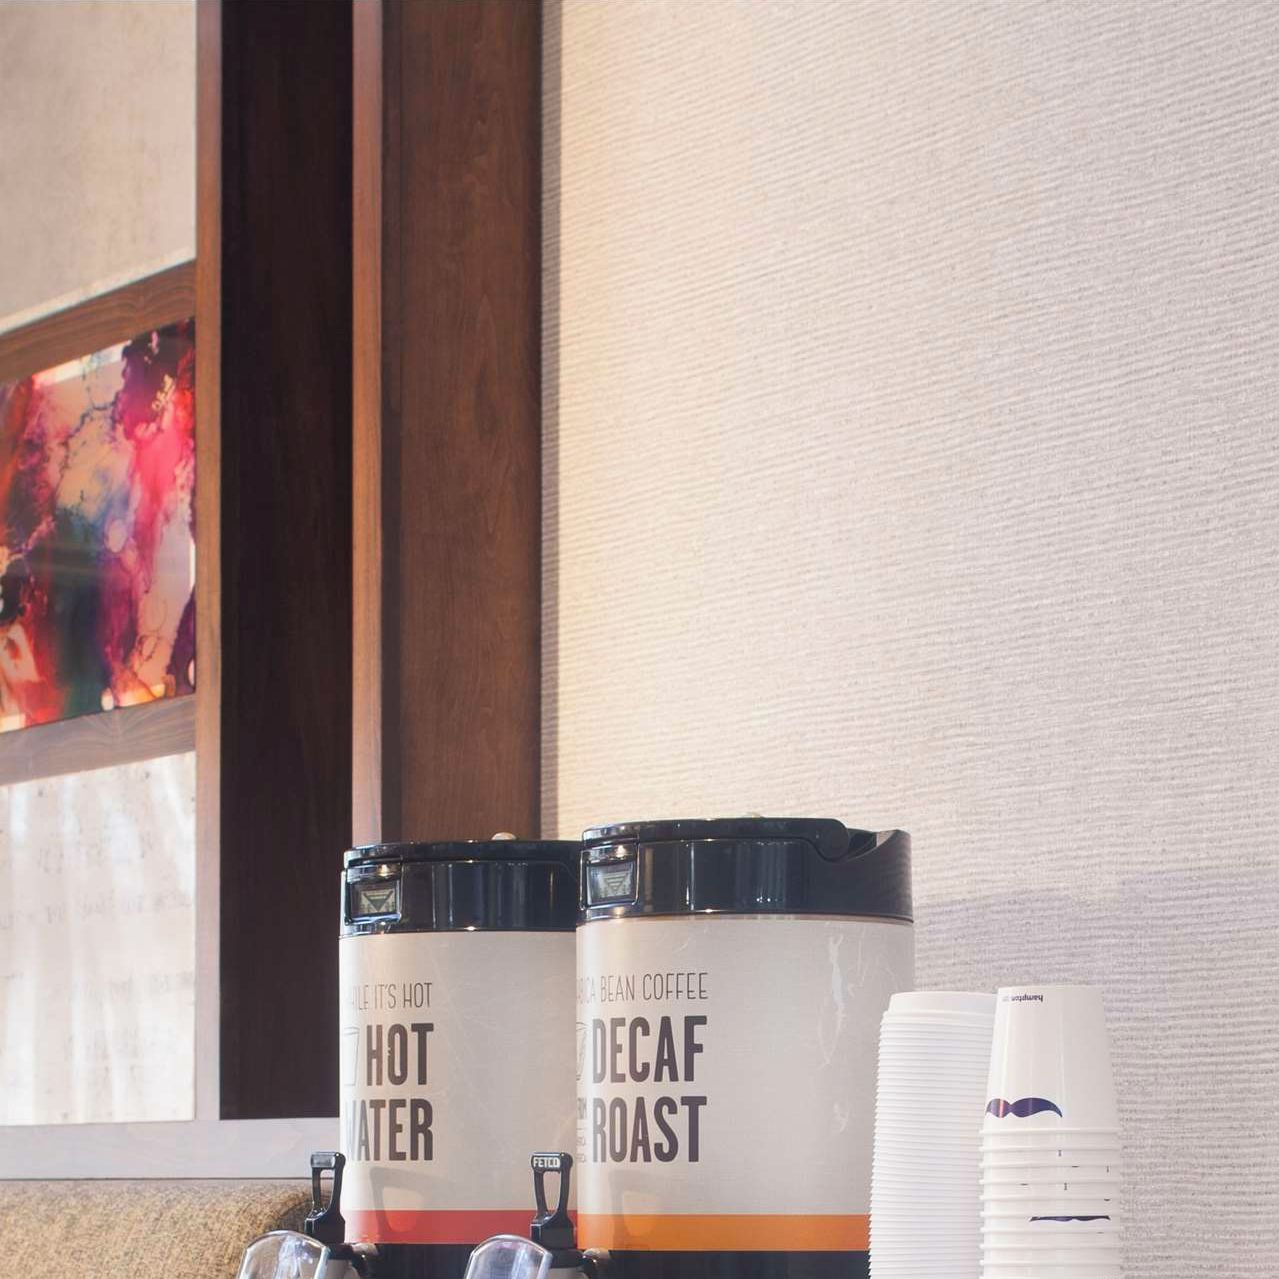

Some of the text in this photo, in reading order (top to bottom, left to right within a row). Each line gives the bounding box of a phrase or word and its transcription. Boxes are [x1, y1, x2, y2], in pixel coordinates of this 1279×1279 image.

[374, 983, 397, 1010] IT'S
[403, 982, 433, 1009] HOT
[600, 974, 635, 1003] BEAN
[642, 972, 708, 1001] COFFEE
[366, 1022, 434, 1087] HOT
[592, 1015, 708, 1084] DECAF
[592, 1096, 707, 1163] ROAST
[533, 1156, 560, 1168] FETCO
